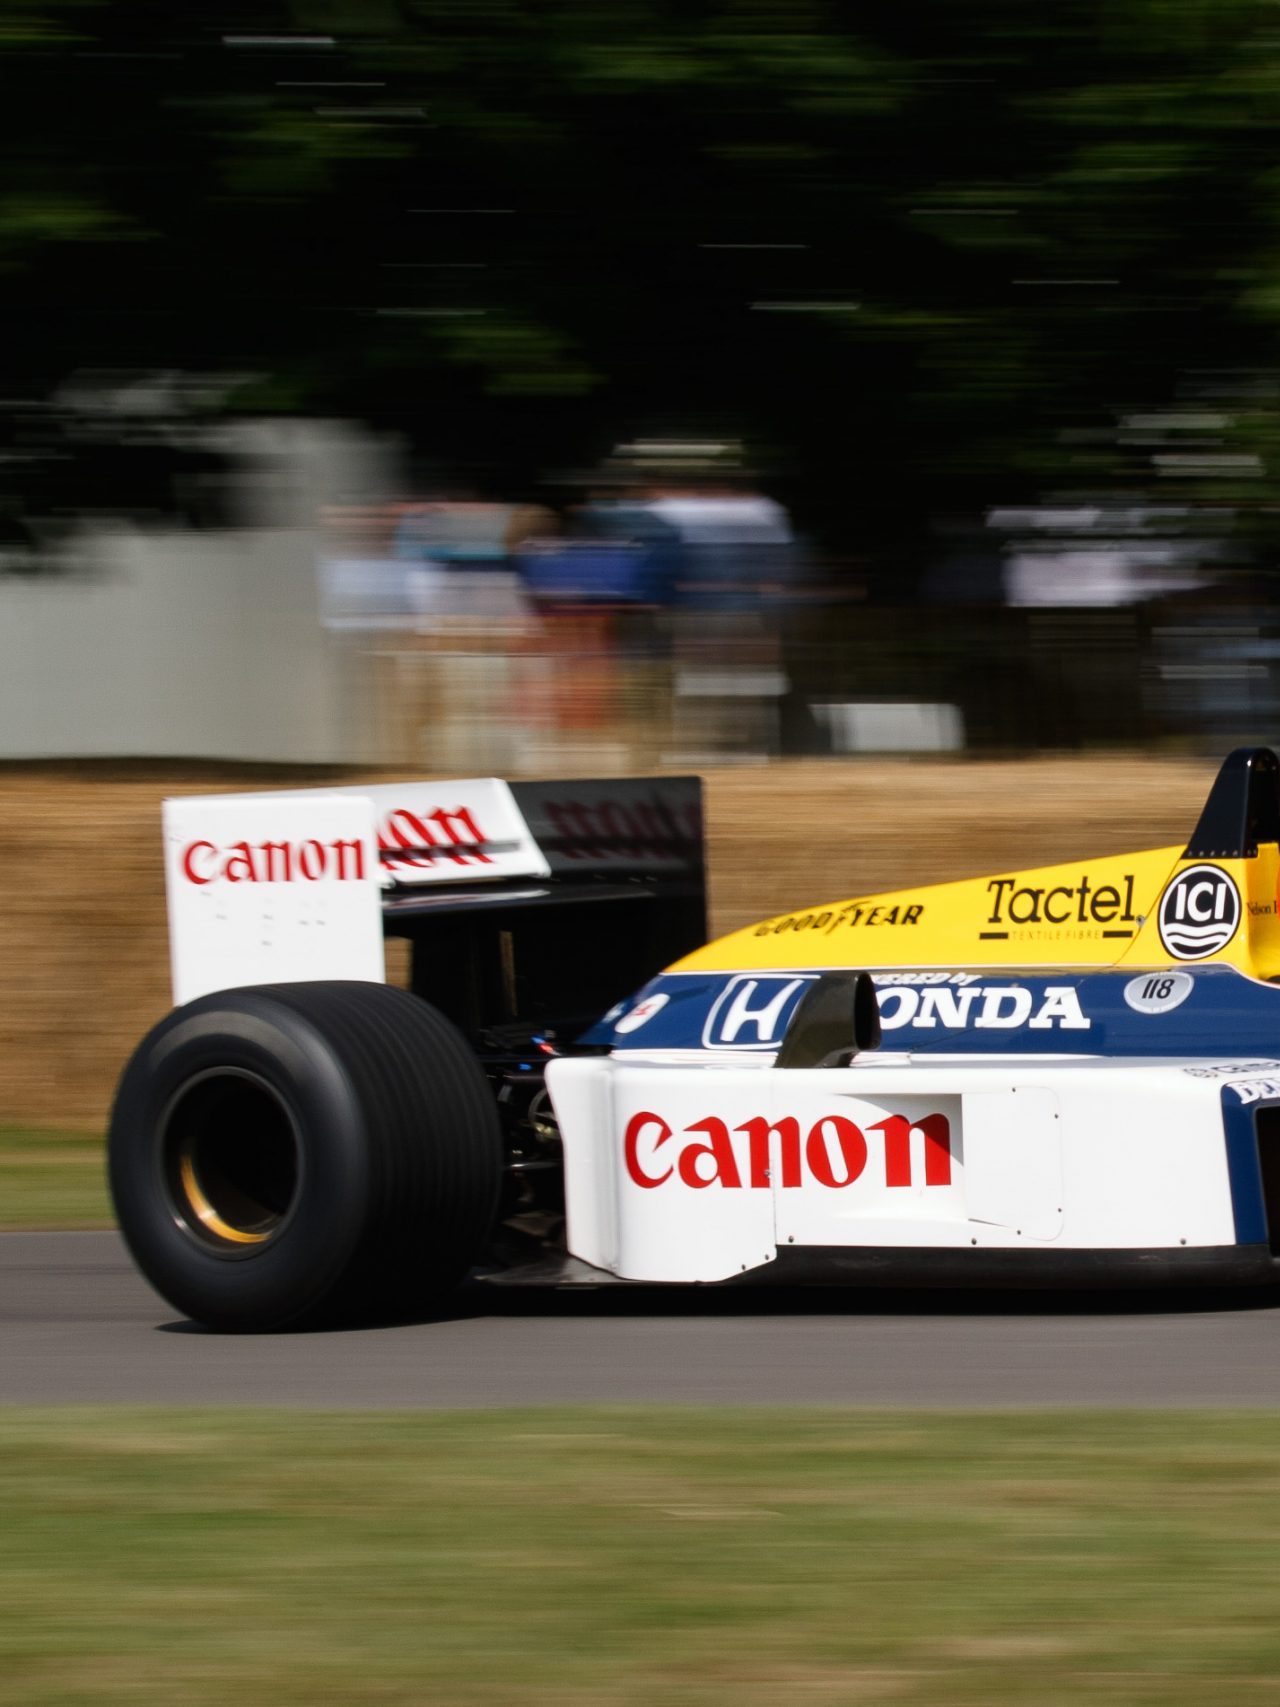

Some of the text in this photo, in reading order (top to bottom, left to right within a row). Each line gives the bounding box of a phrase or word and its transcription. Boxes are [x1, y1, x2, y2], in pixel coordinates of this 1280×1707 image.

[181, 838, 367, 885] Canon
[987, 875, 1135, 924] Tactel
[1175, 881, 1227, 922] ICI
[876, 987, 1091, 1030] ONDA
[1142, 979, 1175, 999] 118
[624, 1111, 951, 1189] Canon
